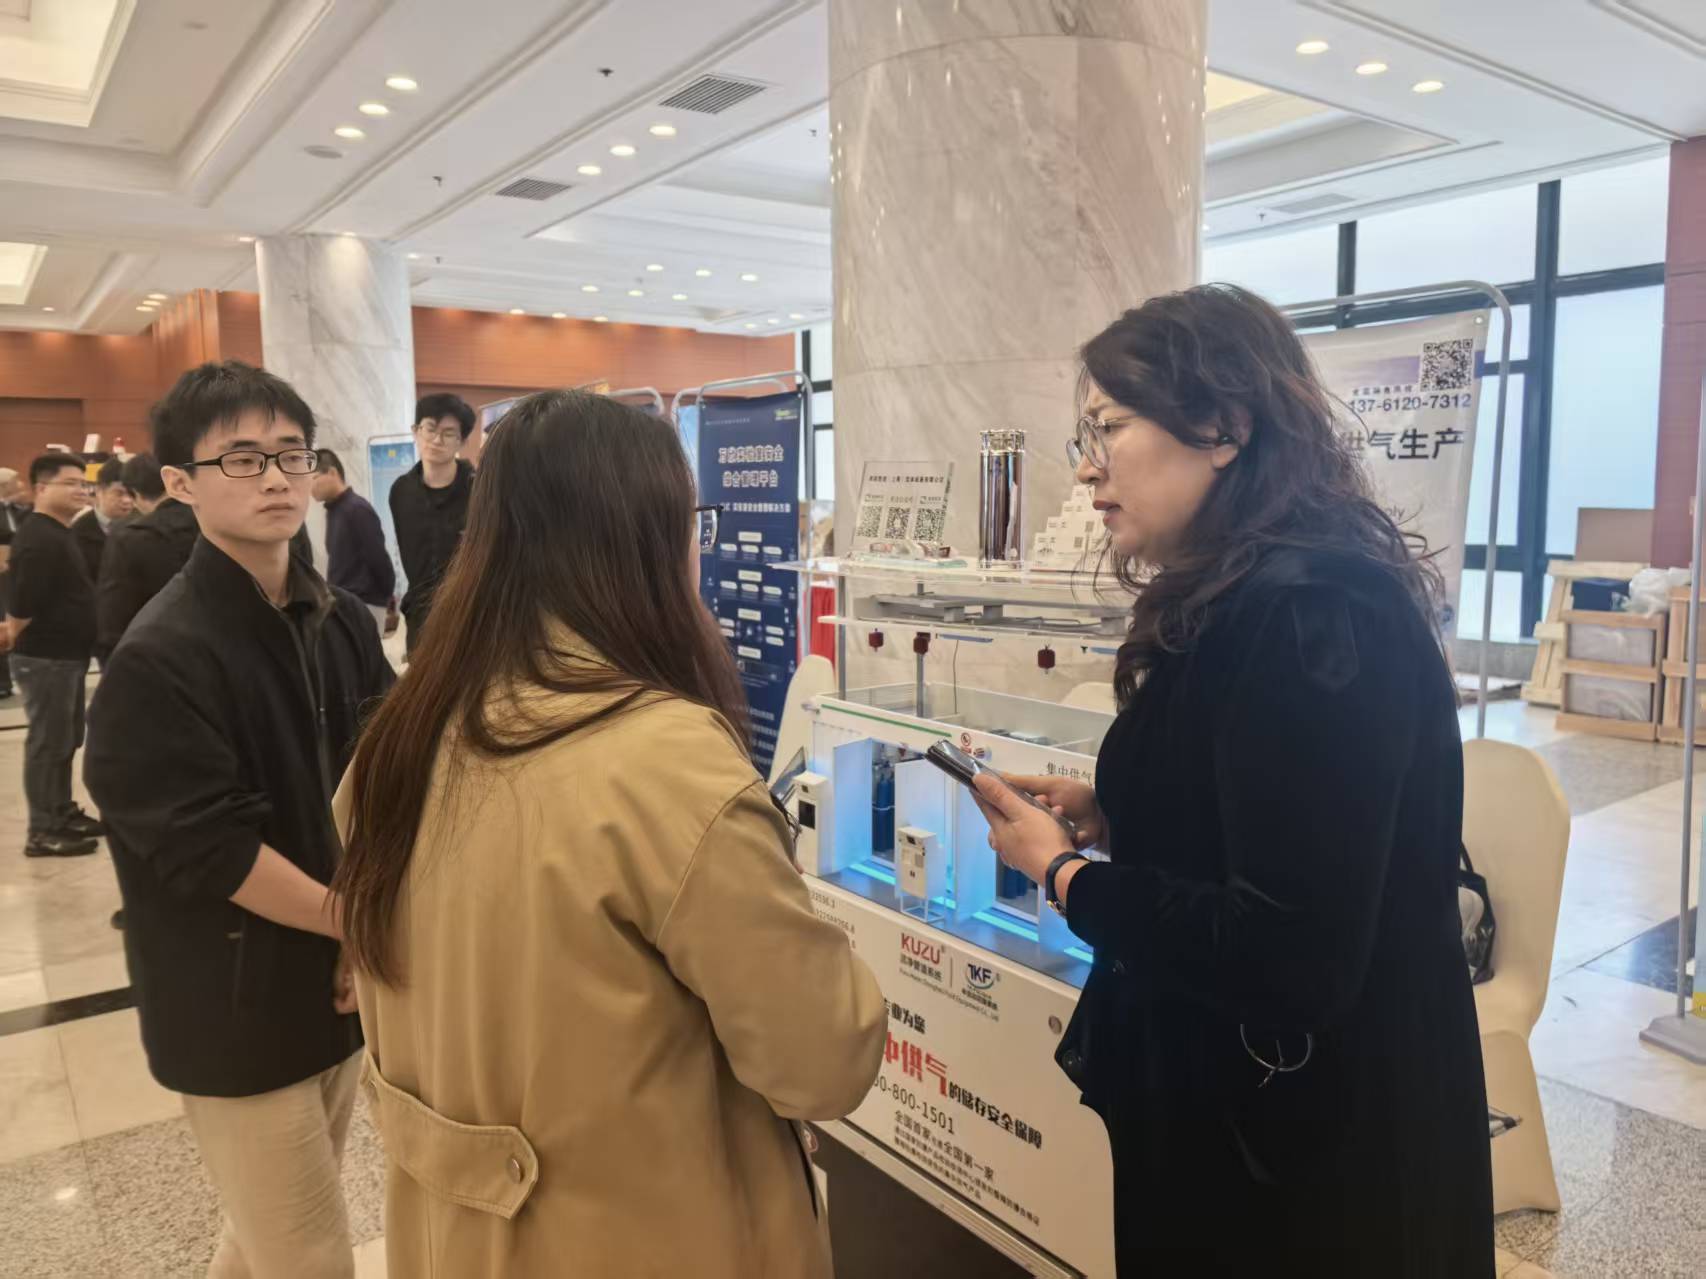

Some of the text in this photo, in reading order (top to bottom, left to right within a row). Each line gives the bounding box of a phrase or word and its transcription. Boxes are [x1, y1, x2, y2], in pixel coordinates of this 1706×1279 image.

[1349, 393, 1472, 413] 137-6120-7312
[900, 932, 940, 965] KUZU
[949, 1082, 1043, 1150] 的储存安全保障
